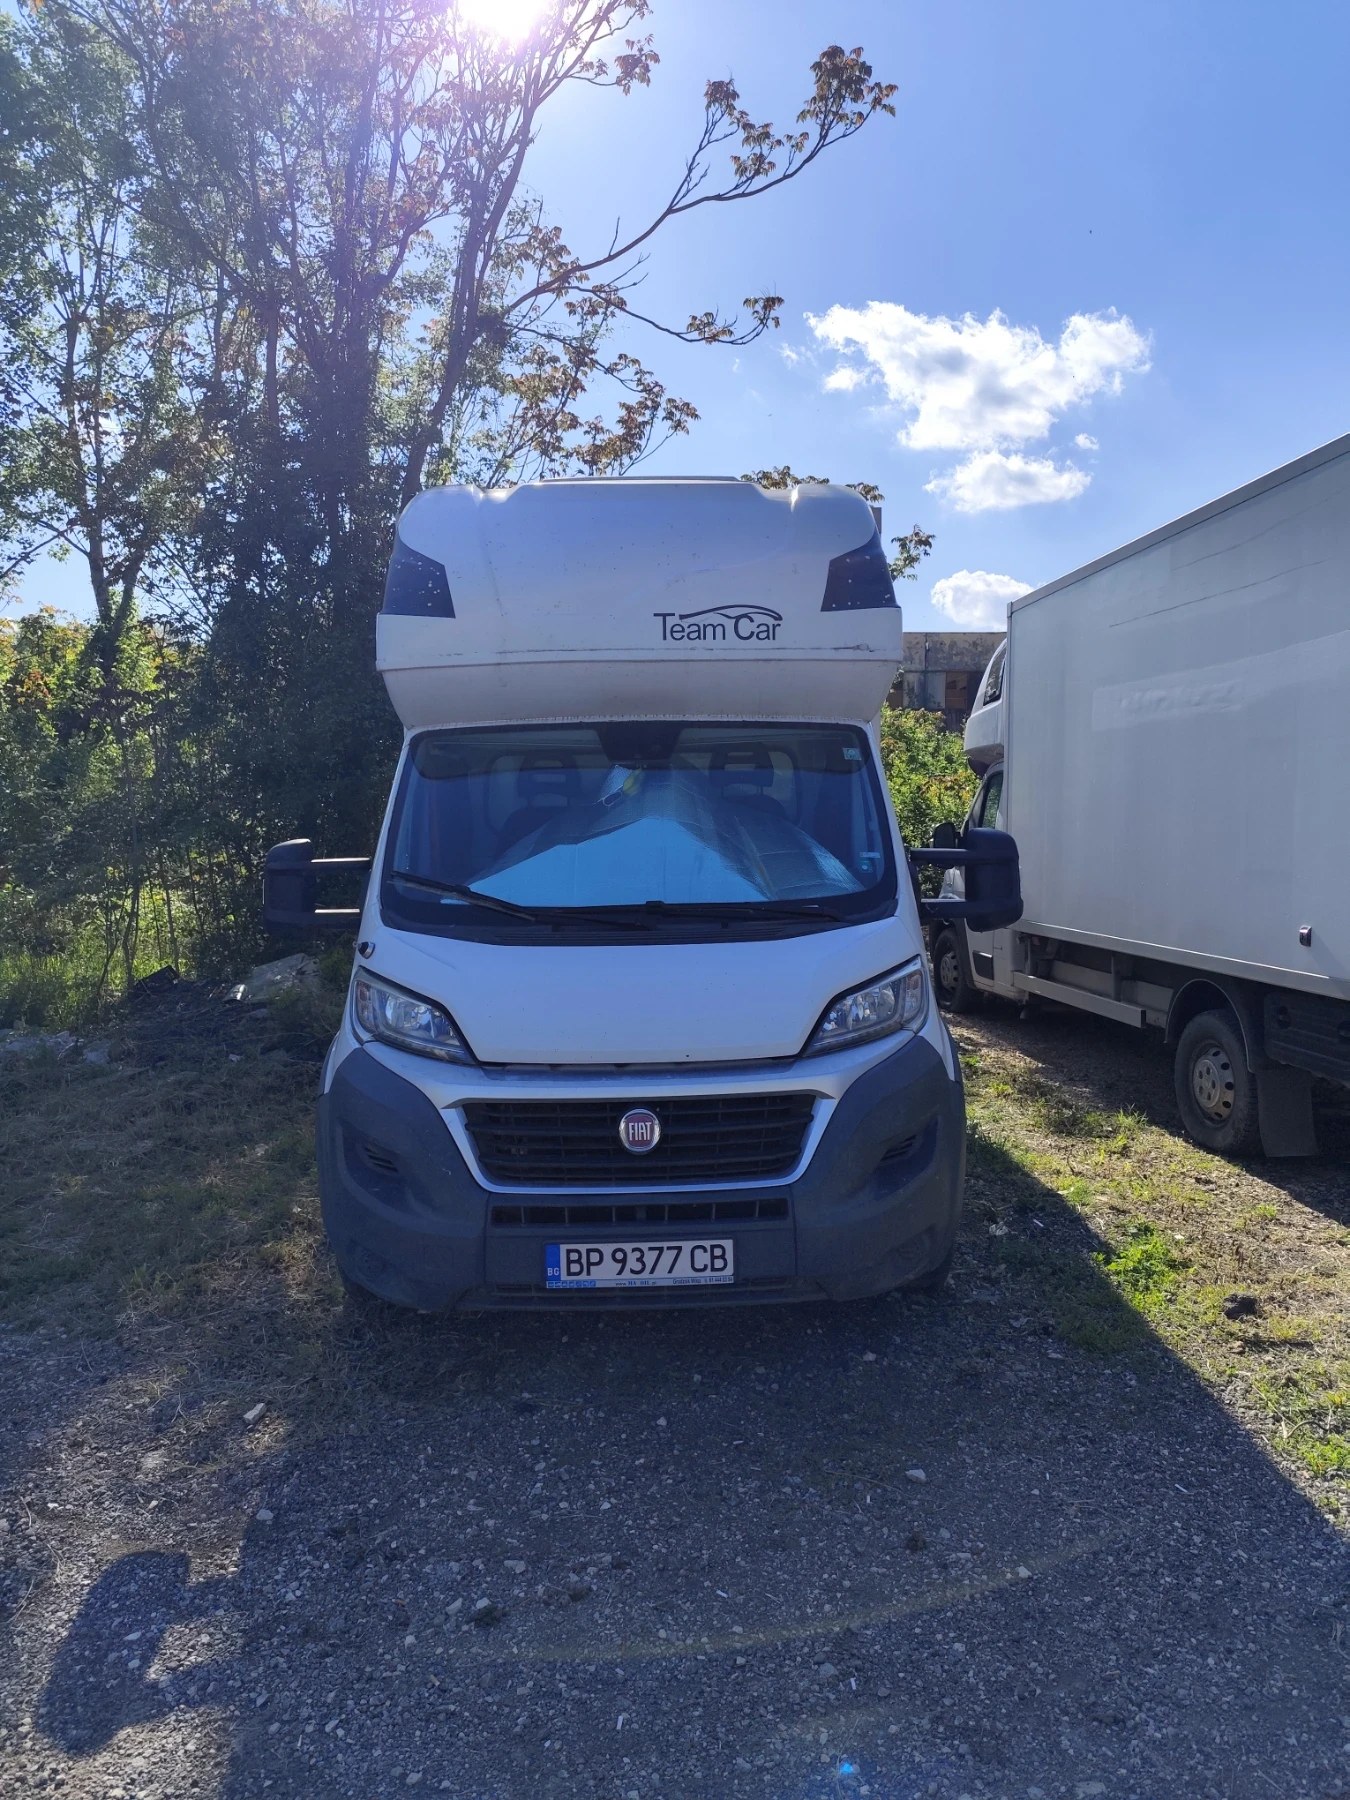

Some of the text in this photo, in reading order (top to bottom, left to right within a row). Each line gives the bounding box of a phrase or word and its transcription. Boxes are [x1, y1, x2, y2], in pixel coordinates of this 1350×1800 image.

[653, 613, 782, 641] Team Car
[628, 1122, 652, 1141] FIAT
[547, 1267, 560, 1276] BG
[565, 1243, 728, 1277] BP 9377 CB
